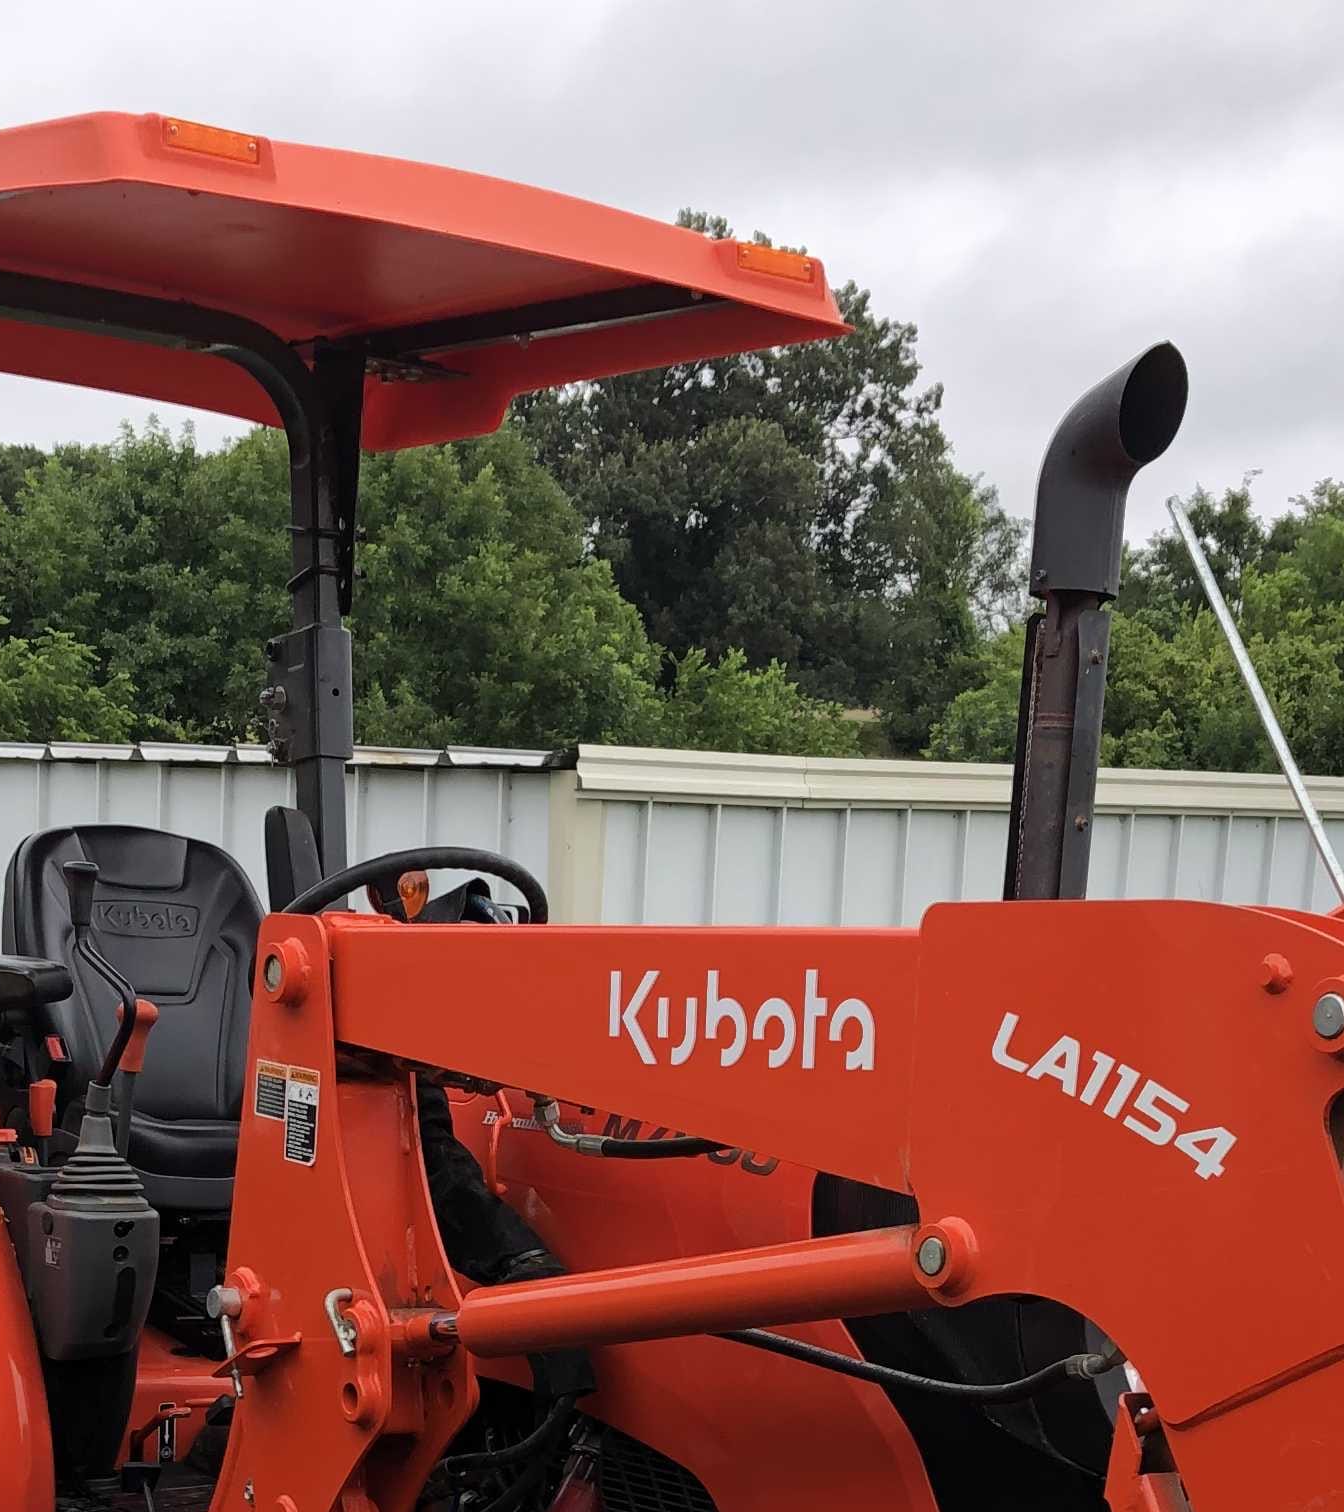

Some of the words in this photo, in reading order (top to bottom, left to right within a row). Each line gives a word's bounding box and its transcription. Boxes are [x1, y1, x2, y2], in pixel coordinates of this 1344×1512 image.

[96, 903, 191, 933] Kubota
[608, 968, 876, 1071] Kubota
[991, 1011, 1238, 1180] LA1154
